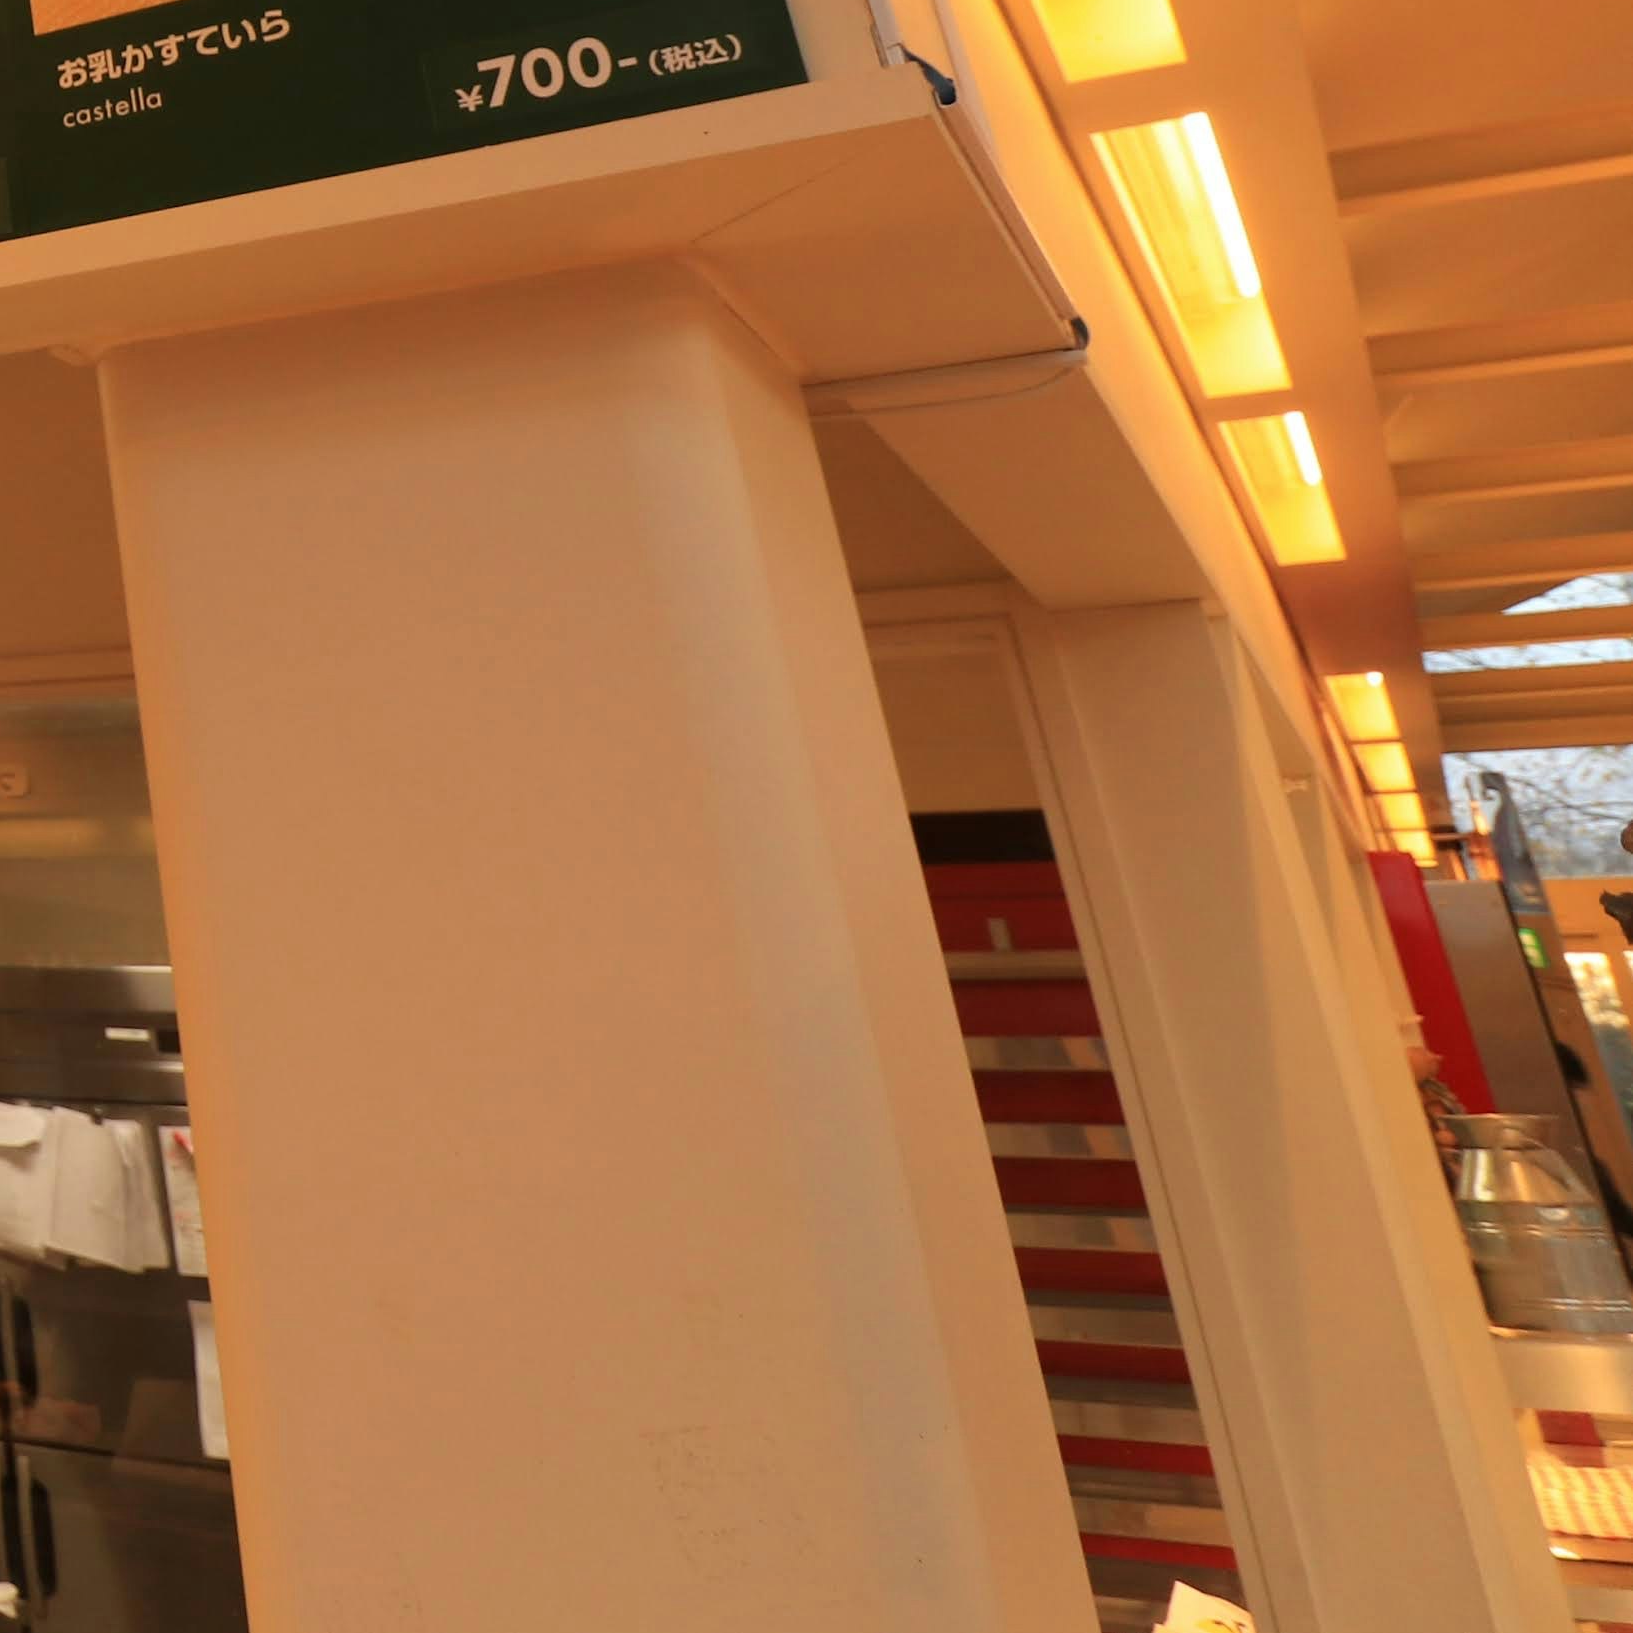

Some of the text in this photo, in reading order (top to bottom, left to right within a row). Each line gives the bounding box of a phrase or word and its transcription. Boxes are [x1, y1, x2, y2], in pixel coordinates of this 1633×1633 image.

[57, 10, 292, 89] お乳かすていら
[648, 34, 742, 77] (税込)
[63, 86, 163, 128] castella
